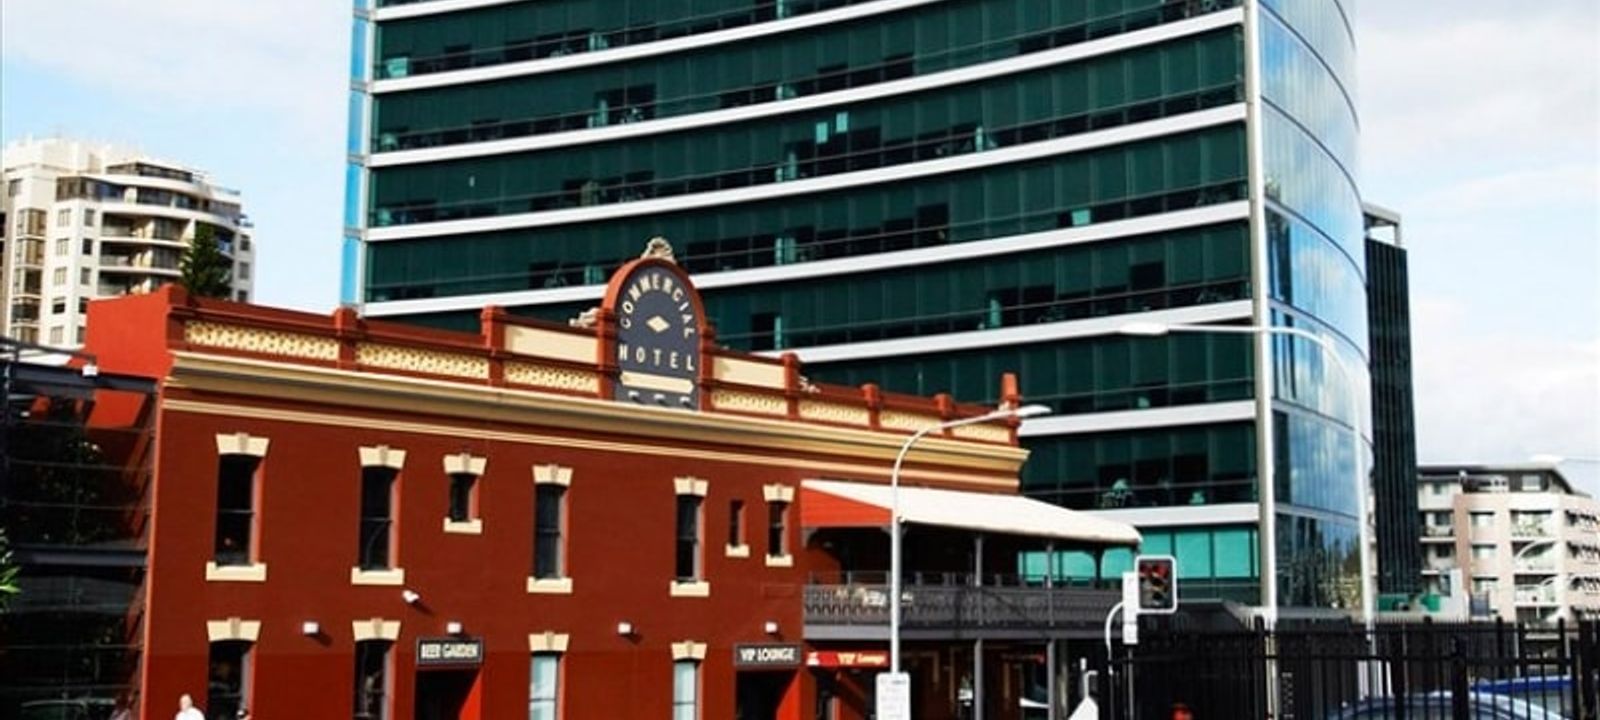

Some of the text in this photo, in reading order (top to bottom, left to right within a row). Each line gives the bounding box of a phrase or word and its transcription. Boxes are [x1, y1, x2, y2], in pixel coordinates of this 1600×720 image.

[621, 274, 694, 338] COMMERCIAL
[618, 344, 694, 371] HOTEL
[443, 643, 478, 658] GARDEN
[740, 648, 795, 661] VIP LOUNGE
